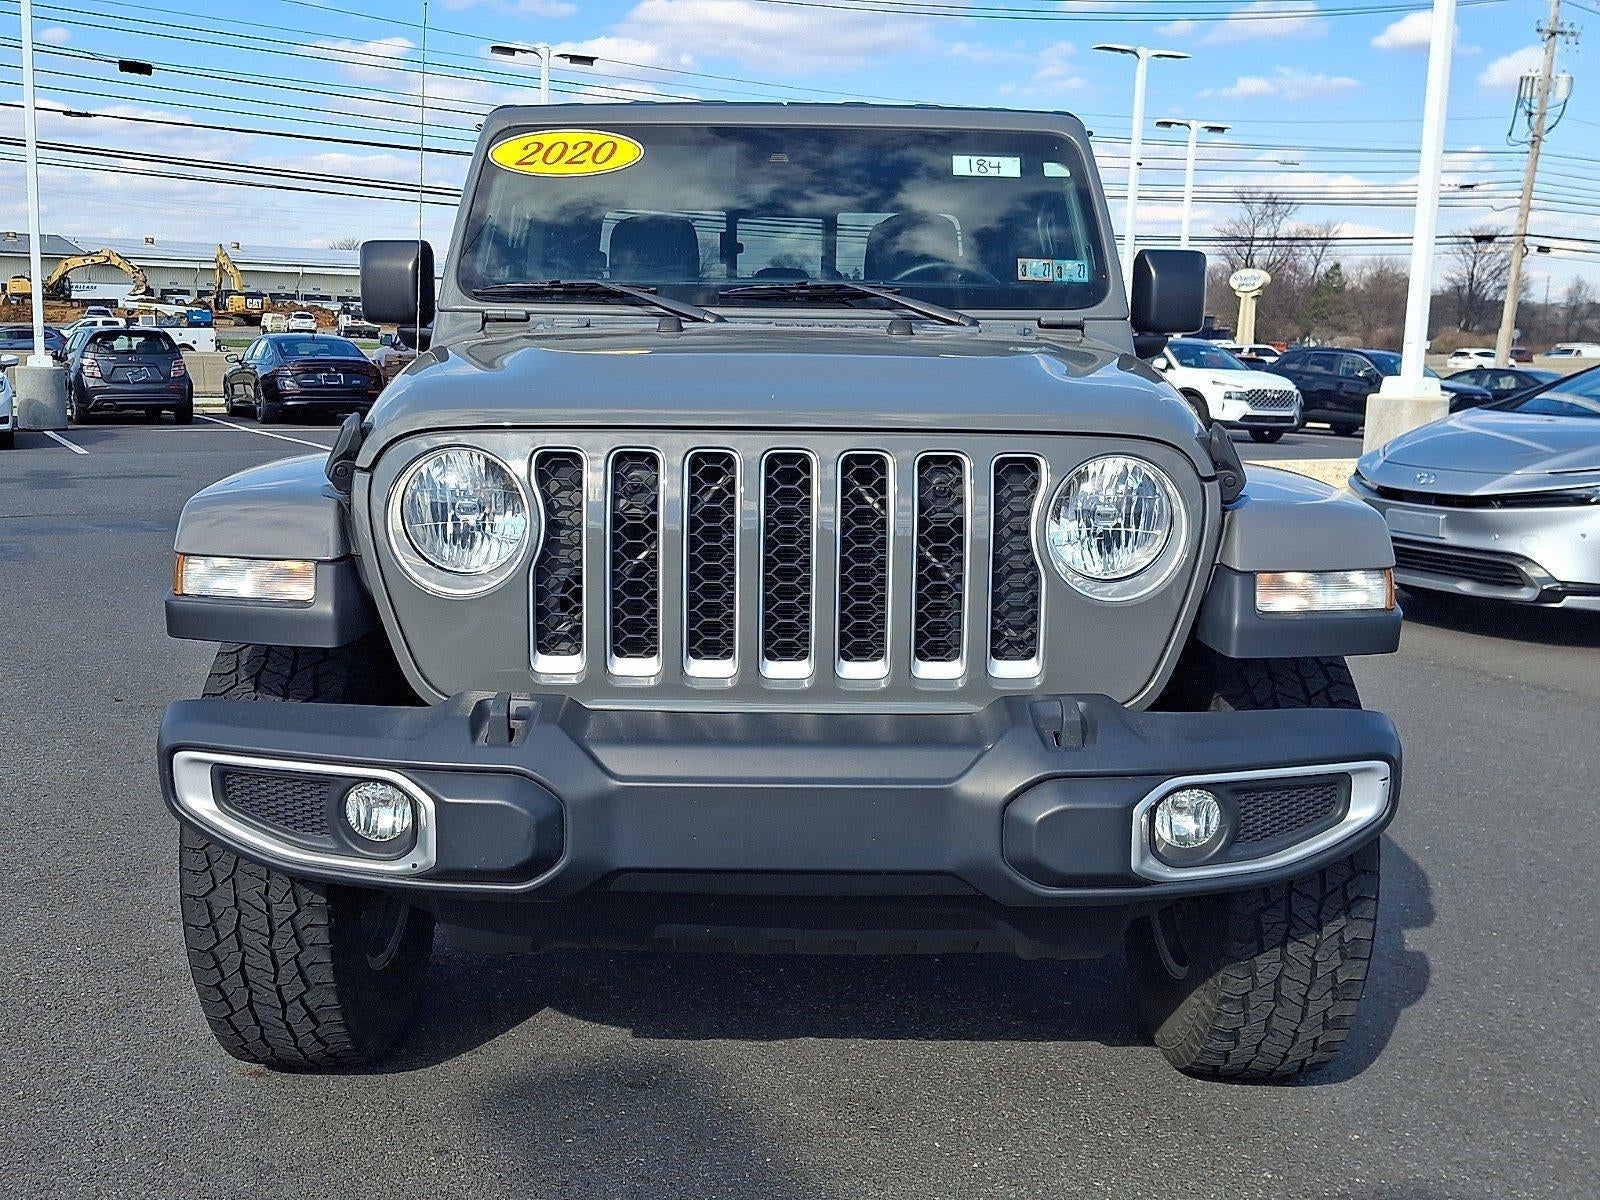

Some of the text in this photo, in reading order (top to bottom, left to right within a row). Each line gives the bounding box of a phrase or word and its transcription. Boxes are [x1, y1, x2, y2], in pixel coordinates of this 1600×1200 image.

[515, 140, 618, 165] 2020
[968, 158, 1002, 174] 184
[247, 298, 263, 309] CAT
